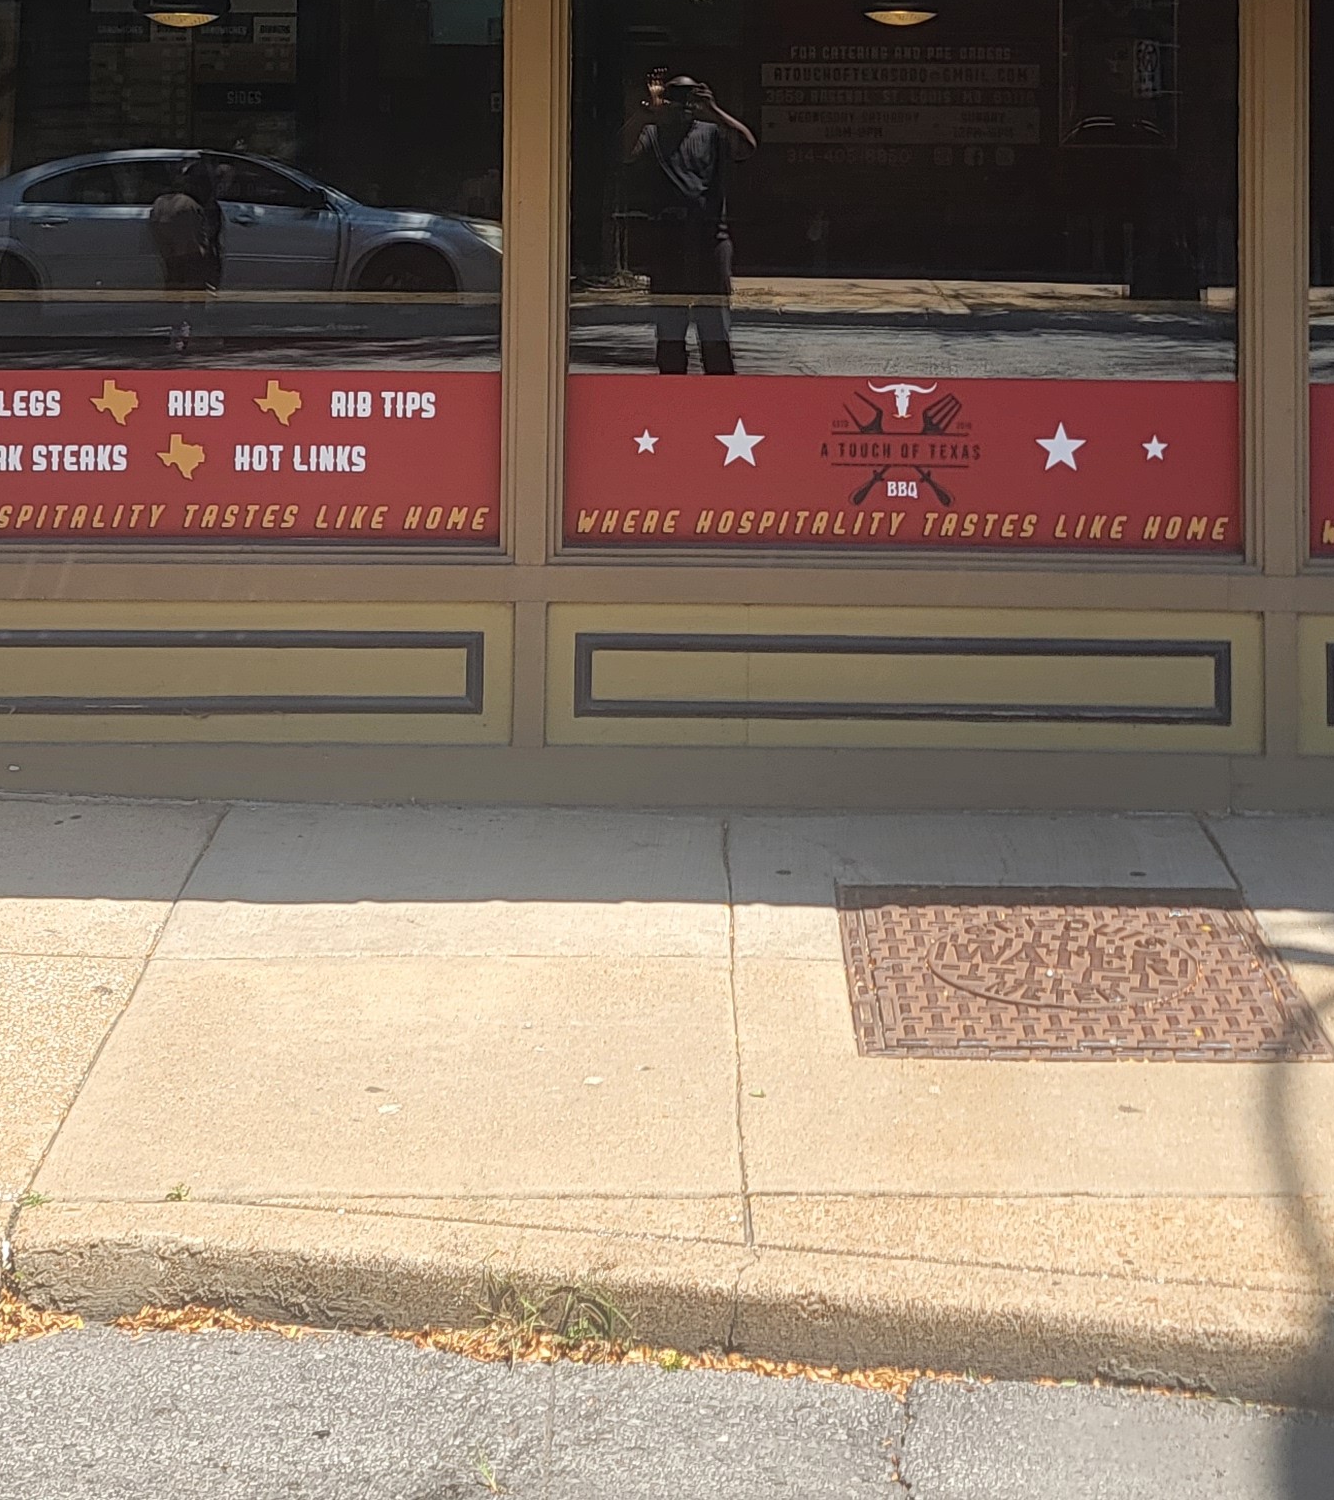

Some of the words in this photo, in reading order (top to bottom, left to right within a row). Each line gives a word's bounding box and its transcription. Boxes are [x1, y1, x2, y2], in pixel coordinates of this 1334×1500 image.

[790, 46, 817, 60] FOR
[822, 46, 889, 60] CATERING
[894, 46, 921, 60] AND
[927, 46, 953, 60] PRE
[959, 47, 1012, 61] ORDERS
[168, 391, 224, 416] RIBS
[331, 391, 371, 417] RIB
[381, 392, 435, 418] TIPS
[33, 445, 127, 470] STEAKS
[235, 445, 283, 470] HOT
[293, 446, 365, 471] LINKS
[821, 443, 828, 458] A
[838, 443, 891, 459] TOUCH
[901, 443, 919, 458] OF
[928, 444, 981, 461] TEXAS
[886, 480, 918, 499] BBQ
[184, 505, 298, 527] TASTES
[316, 506, 388, 528] LIKE
[404, 507, 489, 530] HOME
[578, 510, 680, 532] WHERE
[696, 511, 905, 535] HOSPITALITY
[924, 513, 1037, 537] TASTES
[1055, 515, 1127, 538] LIKE
[1144, 516, 1228, 540] HOME
[952, 942, 1174, 977] WATER
[983, 980, 1128, 1004] METER
